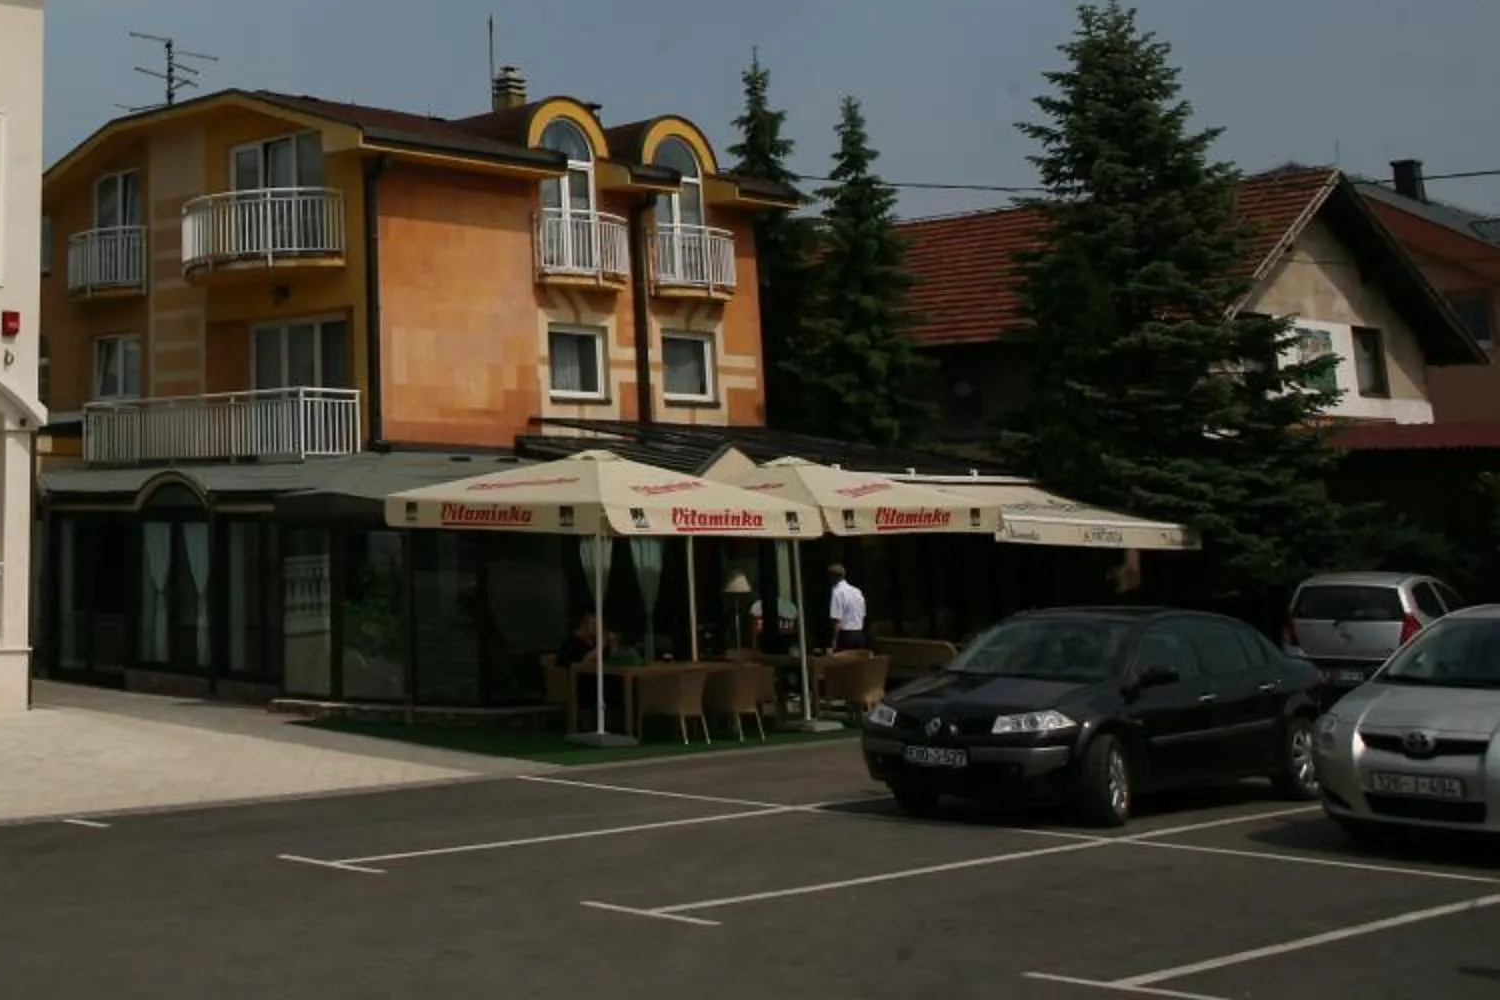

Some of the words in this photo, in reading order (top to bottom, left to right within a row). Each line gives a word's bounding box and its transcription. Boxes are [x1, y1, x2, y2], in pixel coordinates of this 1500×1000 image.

[440, 502, 533, 524] Vitaminka
[671, 506, 764, 529] Vitaminka
[875, 507, 952, 528] Vitaminka
